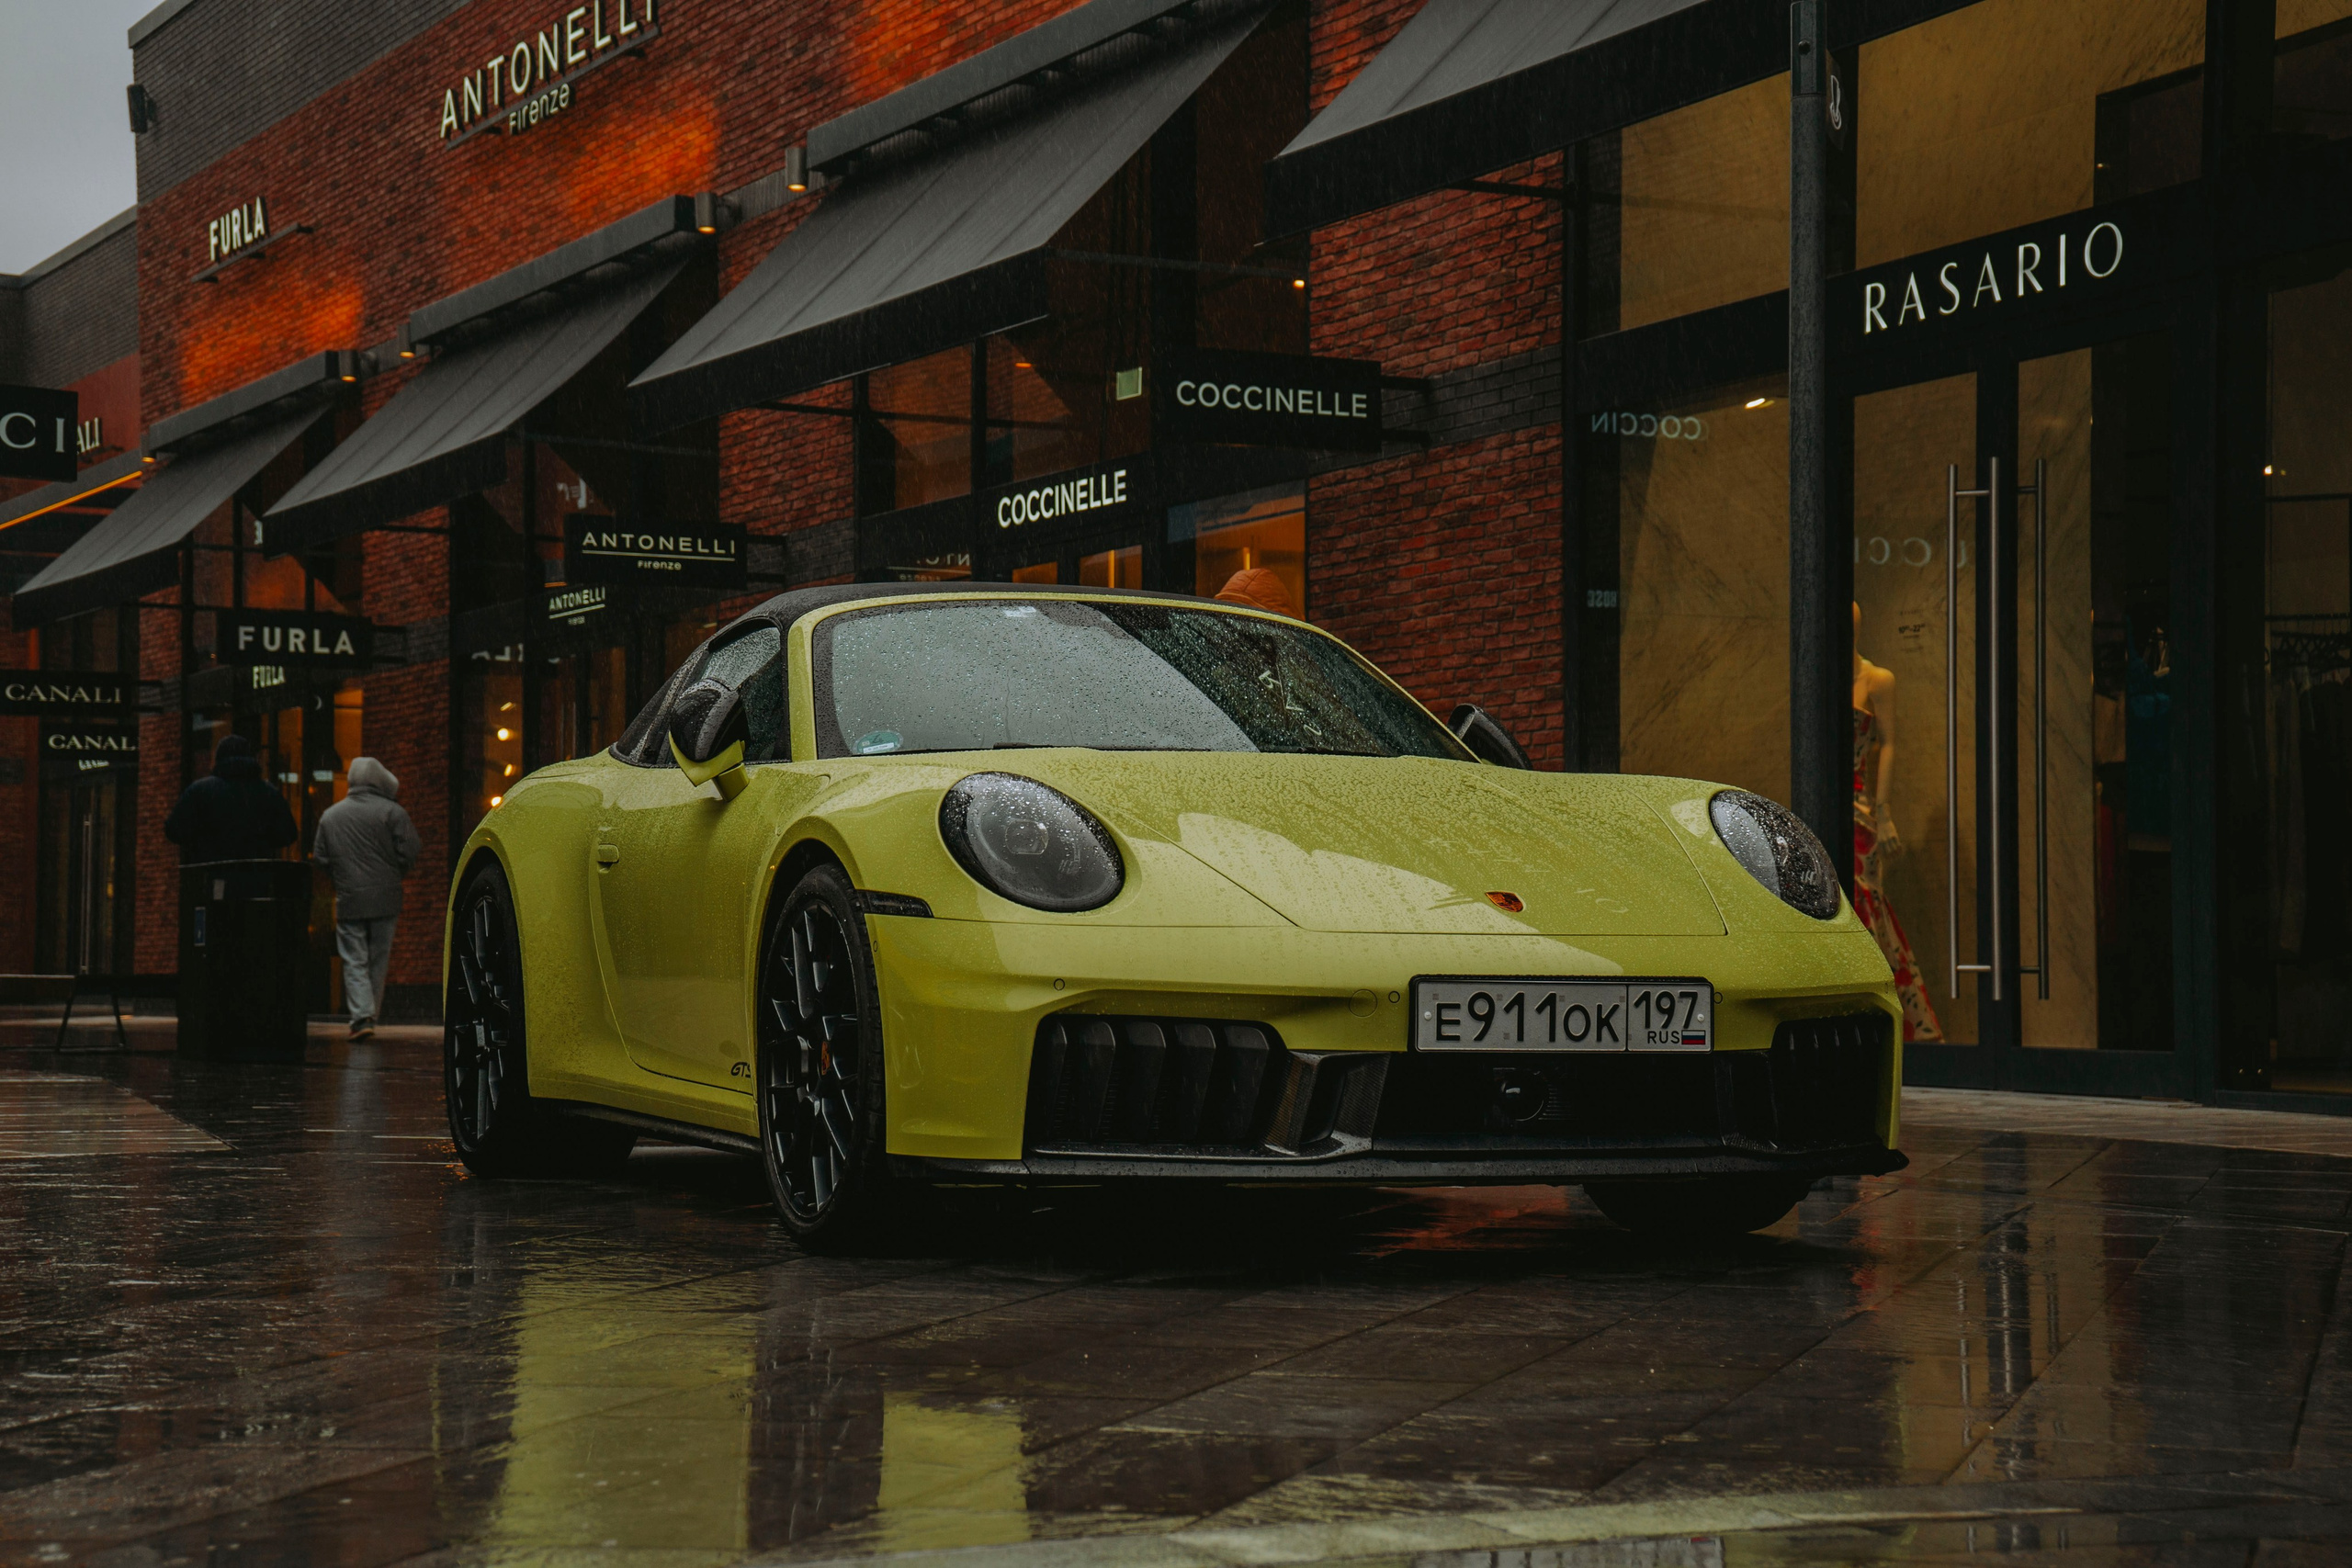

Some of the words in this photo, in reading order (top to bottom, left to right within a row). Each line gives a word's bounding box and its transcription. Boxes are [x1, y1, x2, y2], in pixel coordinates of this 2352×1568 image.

[209, 195, 266, 262] FURLA
[1863, 221, 2123, 335] RASARIO
[1176, 379, 1368, 419] COCCINELLE
[997, 468, 1127, 529] COCCINELLE
[582, 531, 735, 555] ANTONELLI
[548, 586, 606, 612] ANTONELLI
[238, 625, 356, 656] FURLA
[5, 682, 122, 705] CANALI
[48, 734, 139, 751] CANAL
[1435, 991, 1620, 1043] E911OK
[1634, 990, 1699, 1029] 197
[1646, 1030, 1680, 1044] RUS
